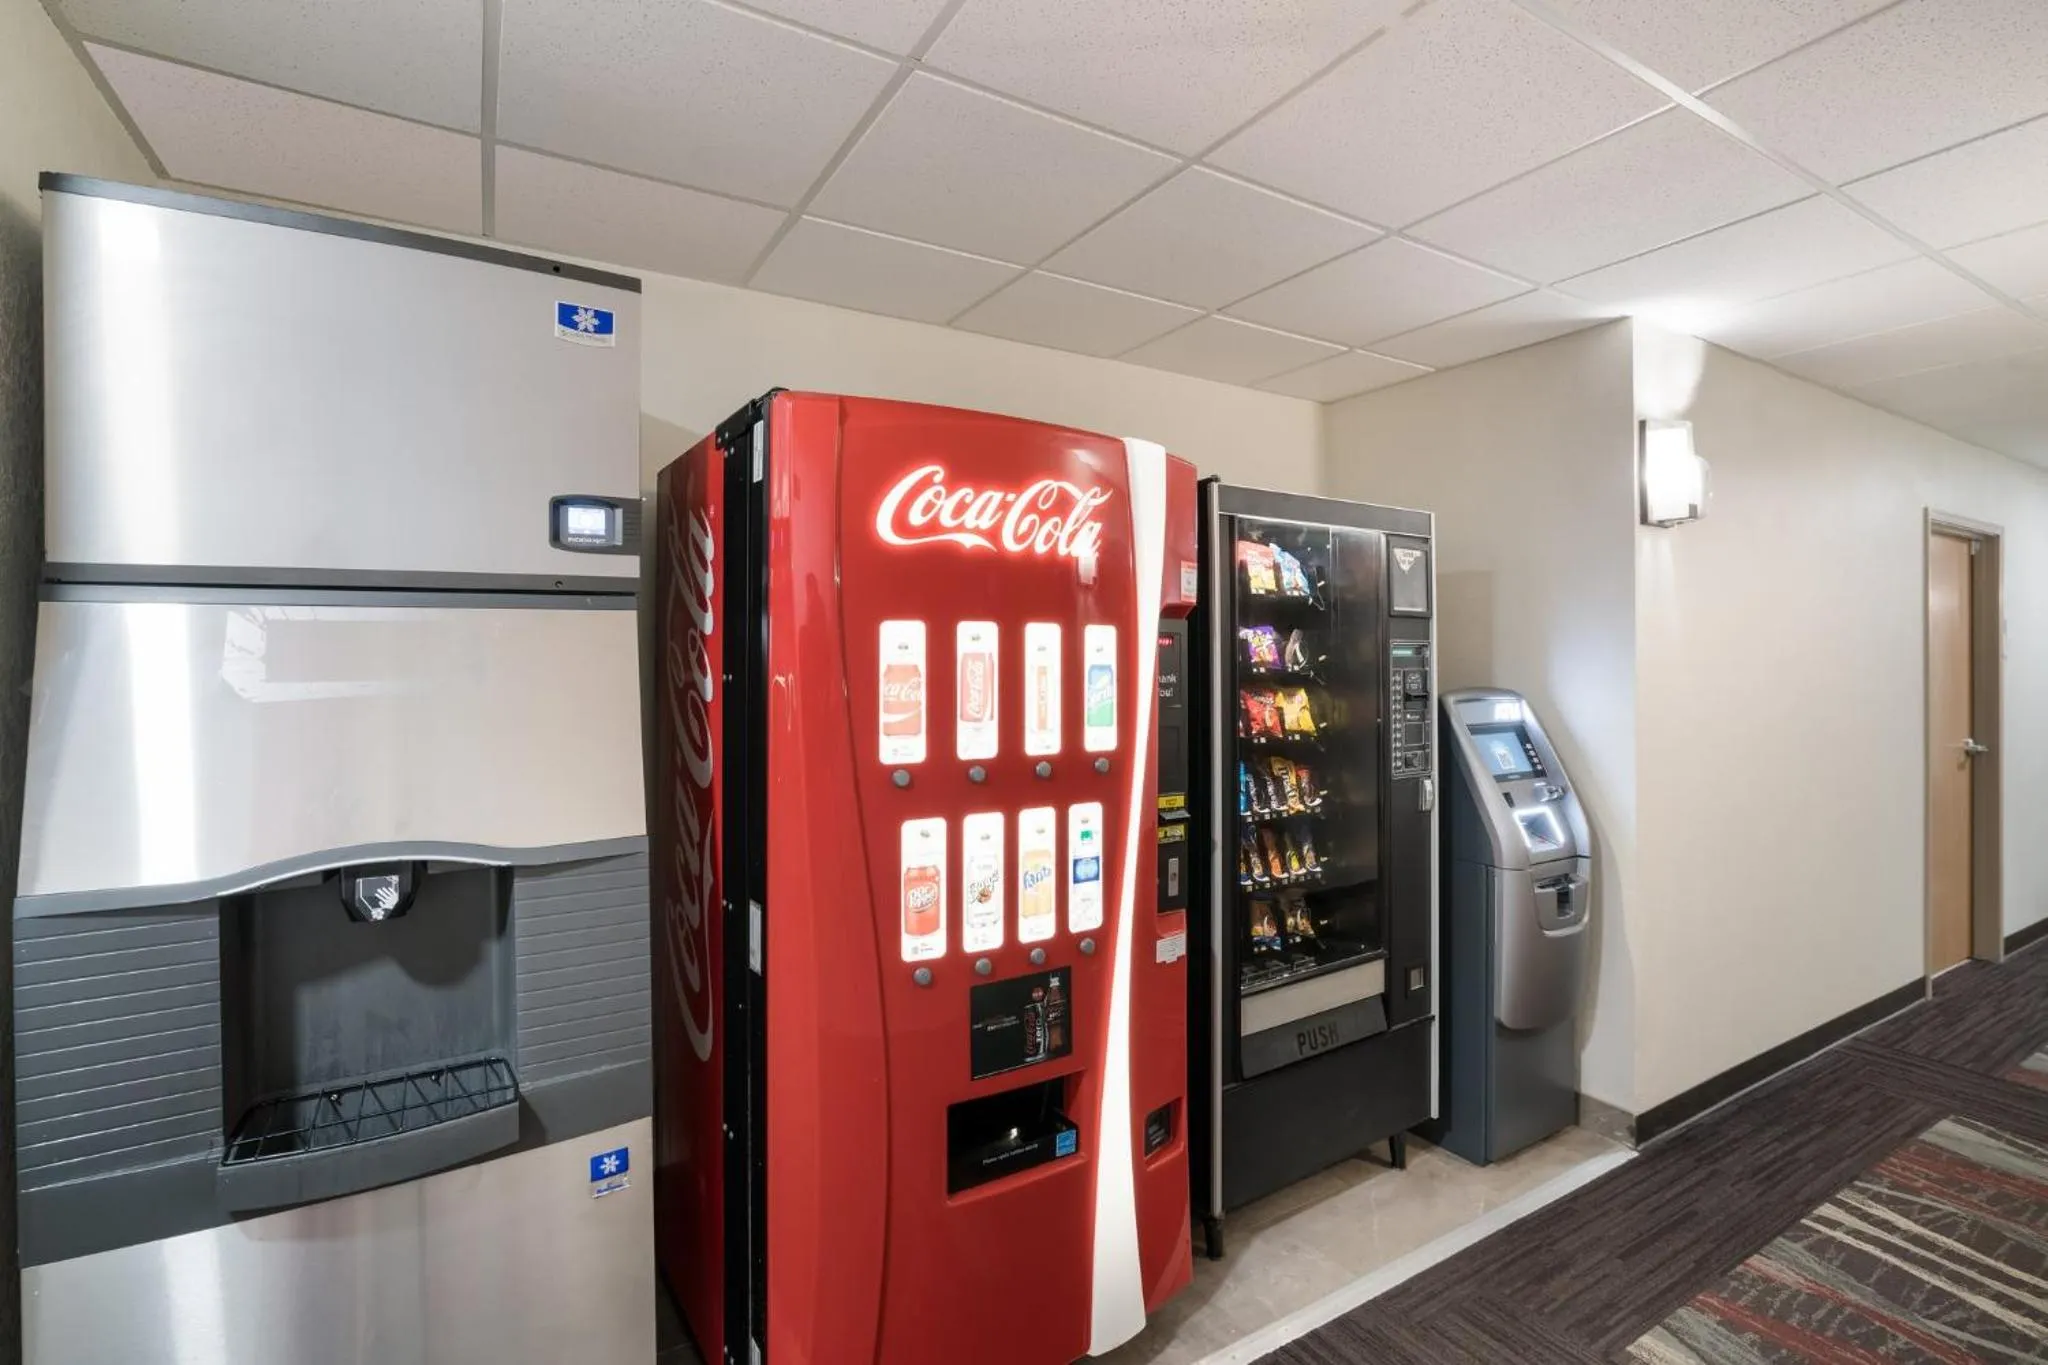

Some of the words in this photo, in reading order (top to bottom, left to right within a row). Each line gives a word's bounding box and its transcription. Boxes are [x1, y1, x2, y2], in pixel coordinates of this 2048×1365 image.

[876, 465, 1113, 557] Coca-Cola
[1157, 673, 1177, 683] ank
[1159, 687, 1174, 697] ou!
[664, 502, 717, 1063] Coca-Cola
[1297, 1022, 1340, 1056] PUSH
